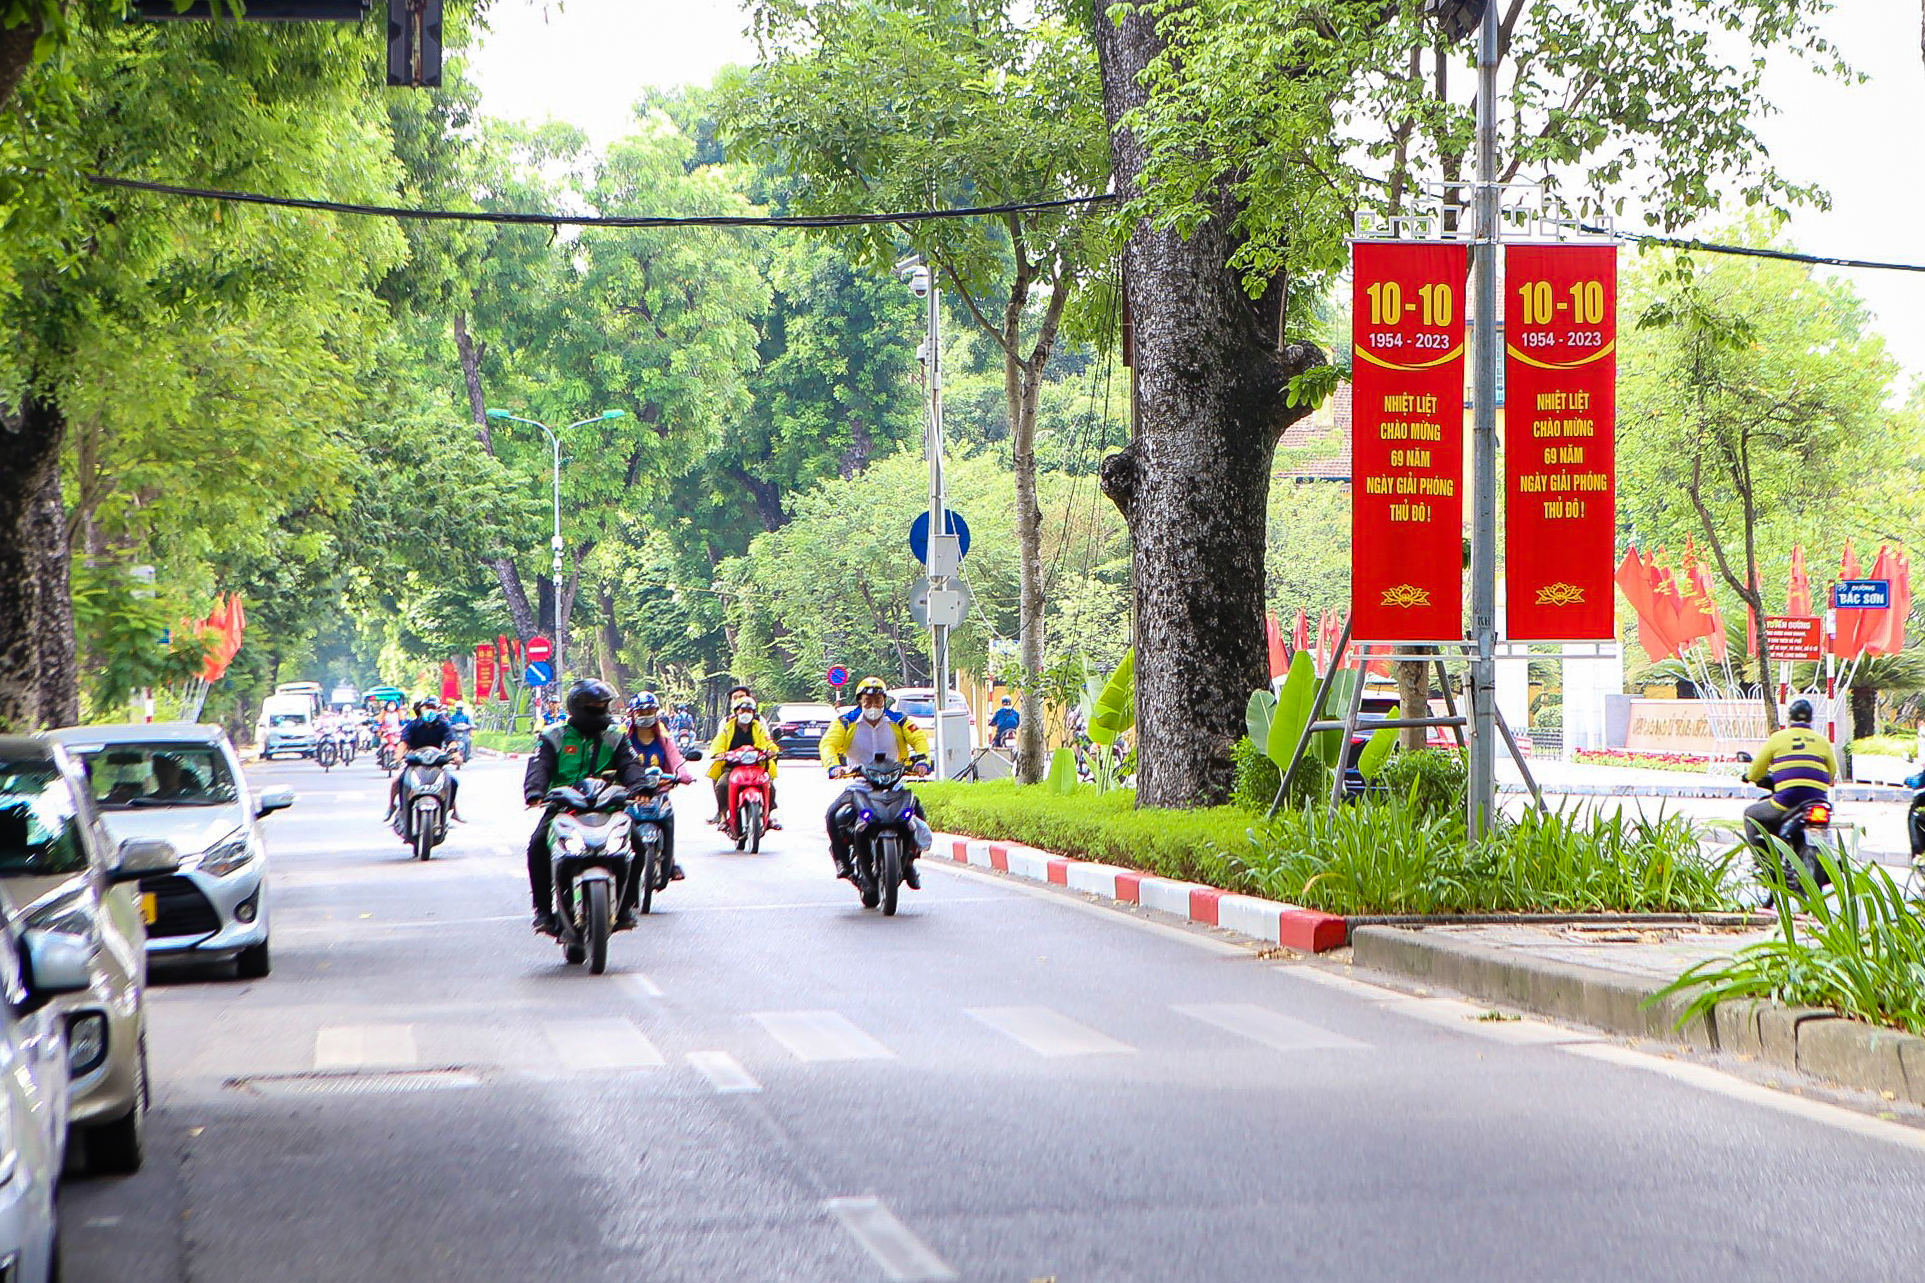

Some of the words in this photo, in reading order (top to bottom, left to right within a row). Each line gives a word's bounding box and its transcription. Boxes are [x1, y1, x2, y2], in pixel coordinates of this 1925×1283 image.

[1369, 332, 1403, 347] 1954
[1415, 333, 1450, 348] 2023
[1521, 331, 1555, 346] 1954
[1567, 331, 1602, 346] 2023
[1384, 391, 1415, 416] NHIỆT
[1416, 392, 1438, 418] LIỆT
[1536, 389, 1566, 414] NHIỆT
[1568, 389, 1590, 413] LIỆT
[1380, 418, 1408, 440] CHÀO
[1410, 419, 1441, 441] MỪNG
[1533, 417, 1561, 437] CHÀO
[1563, 417, 1594, 437] MỪNG
[1390, 449, 1404, 467] 69
[1405, 446, 1431, 468] NĂM
[1543, 446, 1557, 464] 69
[1559, 443, 1583, 464] NĂM
[1366, 473, 1394, 494] NGÀY
[1396, 471, 1418, 494] GIẢI
[1419, 475, 1454, 497] PHÓNG
[1520, 470, 1548, 492] NGÀY
[1549, 468, 1571, 492] GIẢI
[1573, 470, 1608, 491] PHÓNG
[1389, 498, 1410, 522] THỦ
[1543, 496, 1564, 519] THỦ
